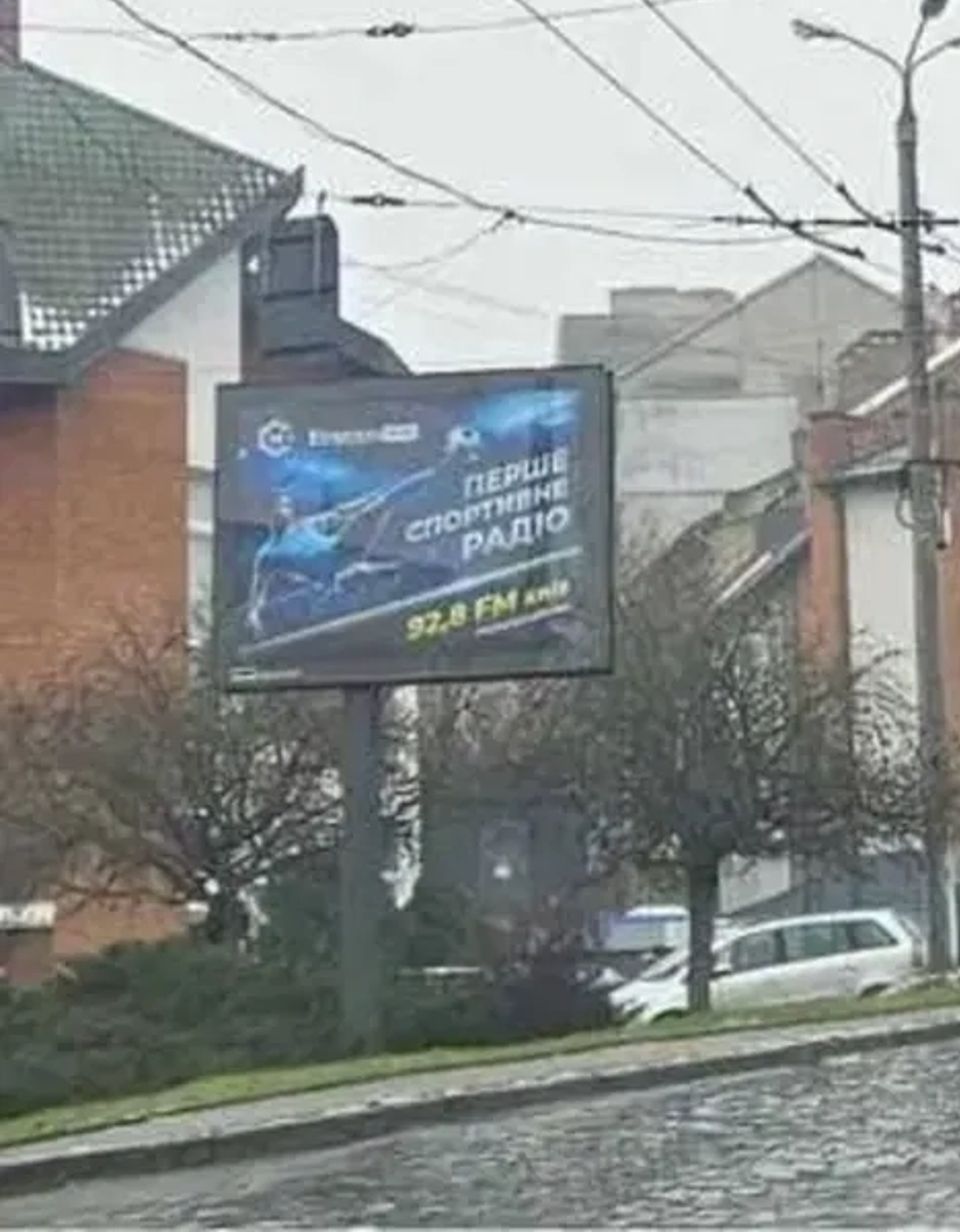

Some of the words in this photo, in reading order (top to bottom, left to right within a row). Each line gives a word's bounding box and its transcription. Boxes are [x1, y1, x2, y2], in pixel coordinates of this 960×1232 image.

[463, 448, 568, 497] ПЕРШЕ
[403, 478, 568, 542] СПОРТИВНЕ
[461, 505, 569, 560] РАДІО
[474, 590, 518, 625] FM
